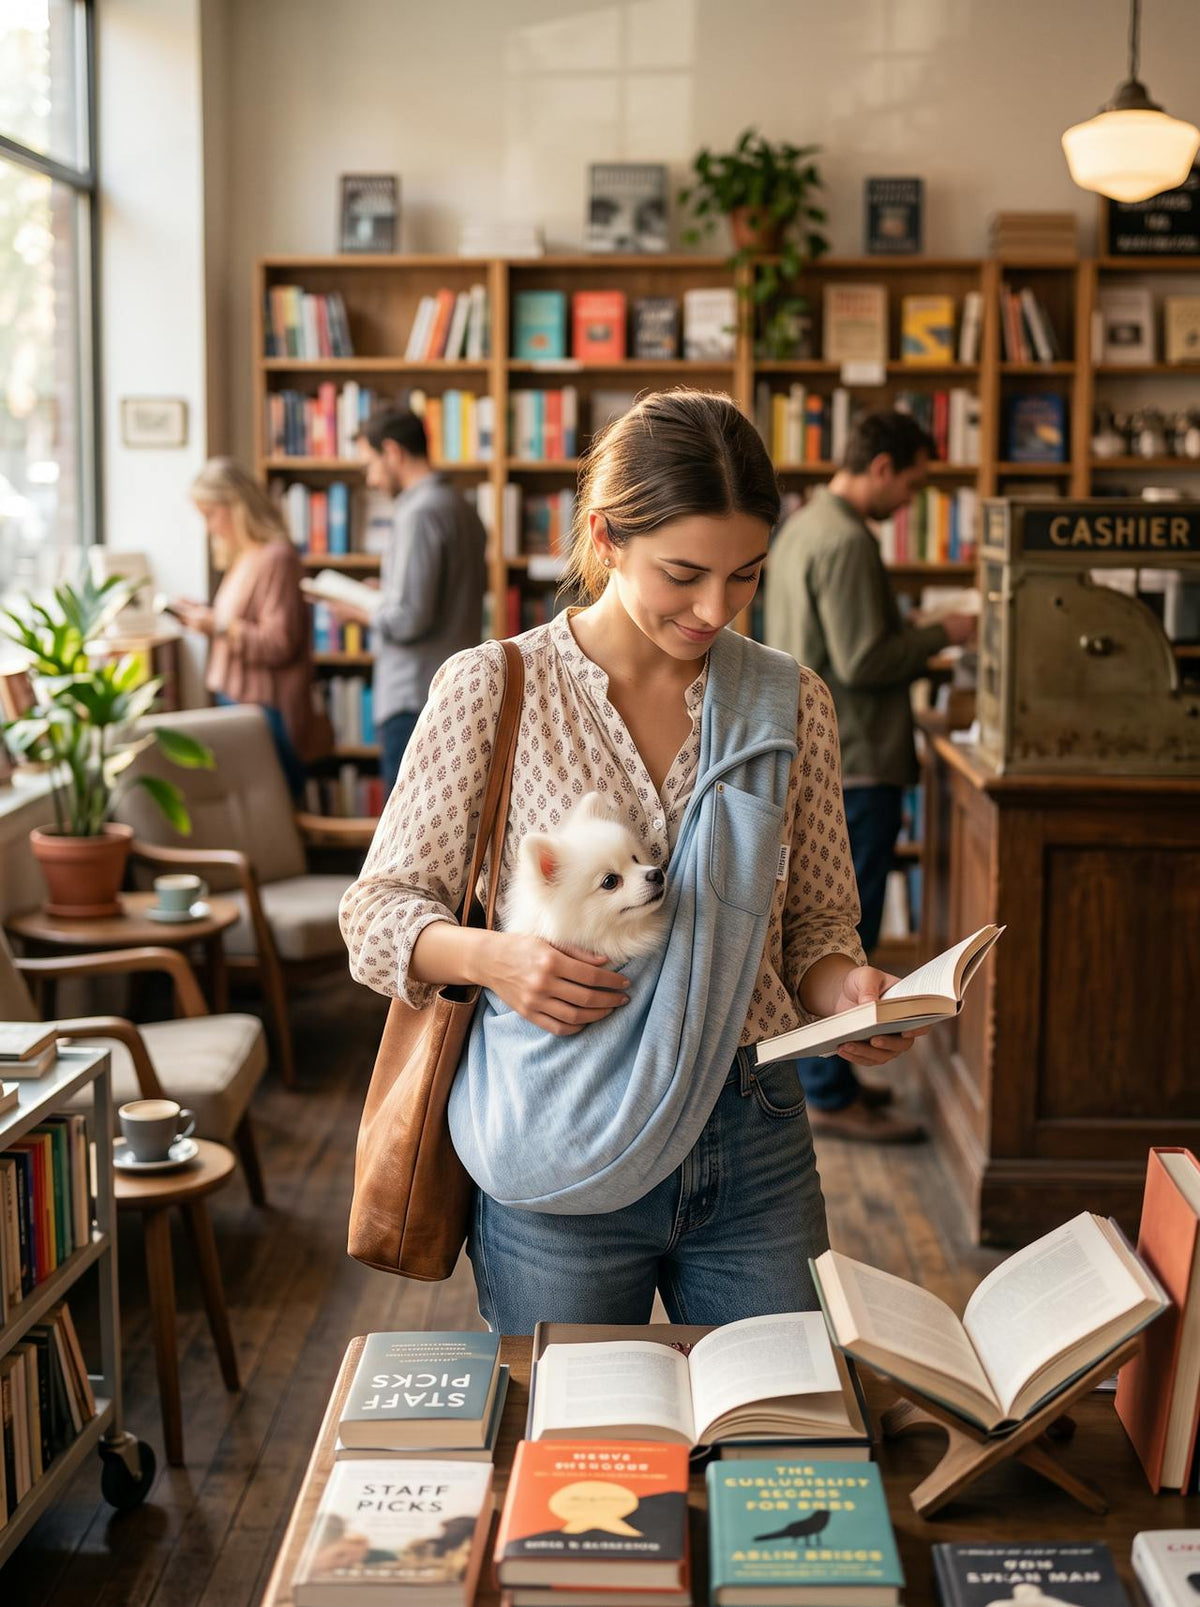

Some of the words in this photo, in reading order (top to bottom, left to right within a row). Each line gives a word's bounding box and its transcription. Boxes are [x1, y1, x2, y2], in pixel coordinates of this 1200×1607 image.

[1049, 516, 1191, 546] CASHIER
[371, 1373, 471, 1388] PICKS
[362, 1392, 466, 1410] STAFF
[776, 1466, 814, 1476] THE
[363, 1484, 450, 1496] STAFF
[357, 1500, 443, 1512] PICKS
